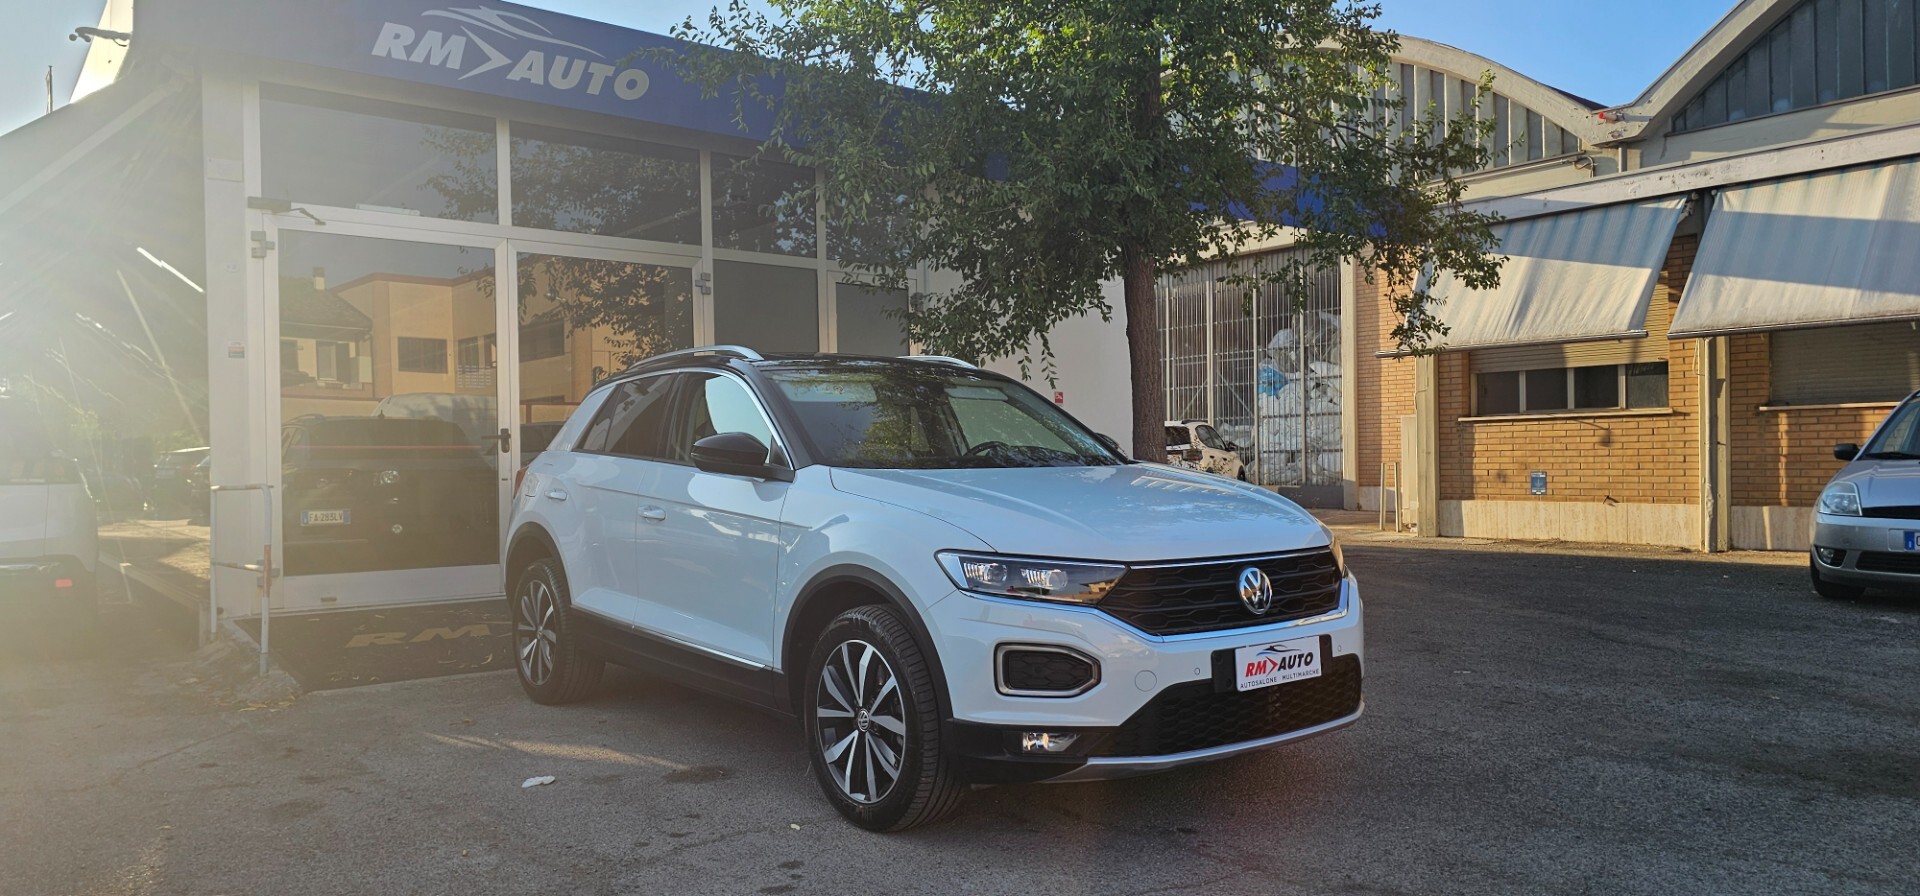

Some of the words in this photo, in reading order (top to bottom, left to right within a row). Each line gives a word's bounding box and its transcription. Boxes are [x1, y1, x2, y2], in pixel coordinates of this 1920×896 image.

[506, 50, 650, 100] AUTO
[345, 624, 492, 648] RM
[1277, 652, 1314, 672] AUTO
[1240, 676, 1277, 689] AUTOSALONE
[1281, 668, 1319, 680] MULTIMARCHE
